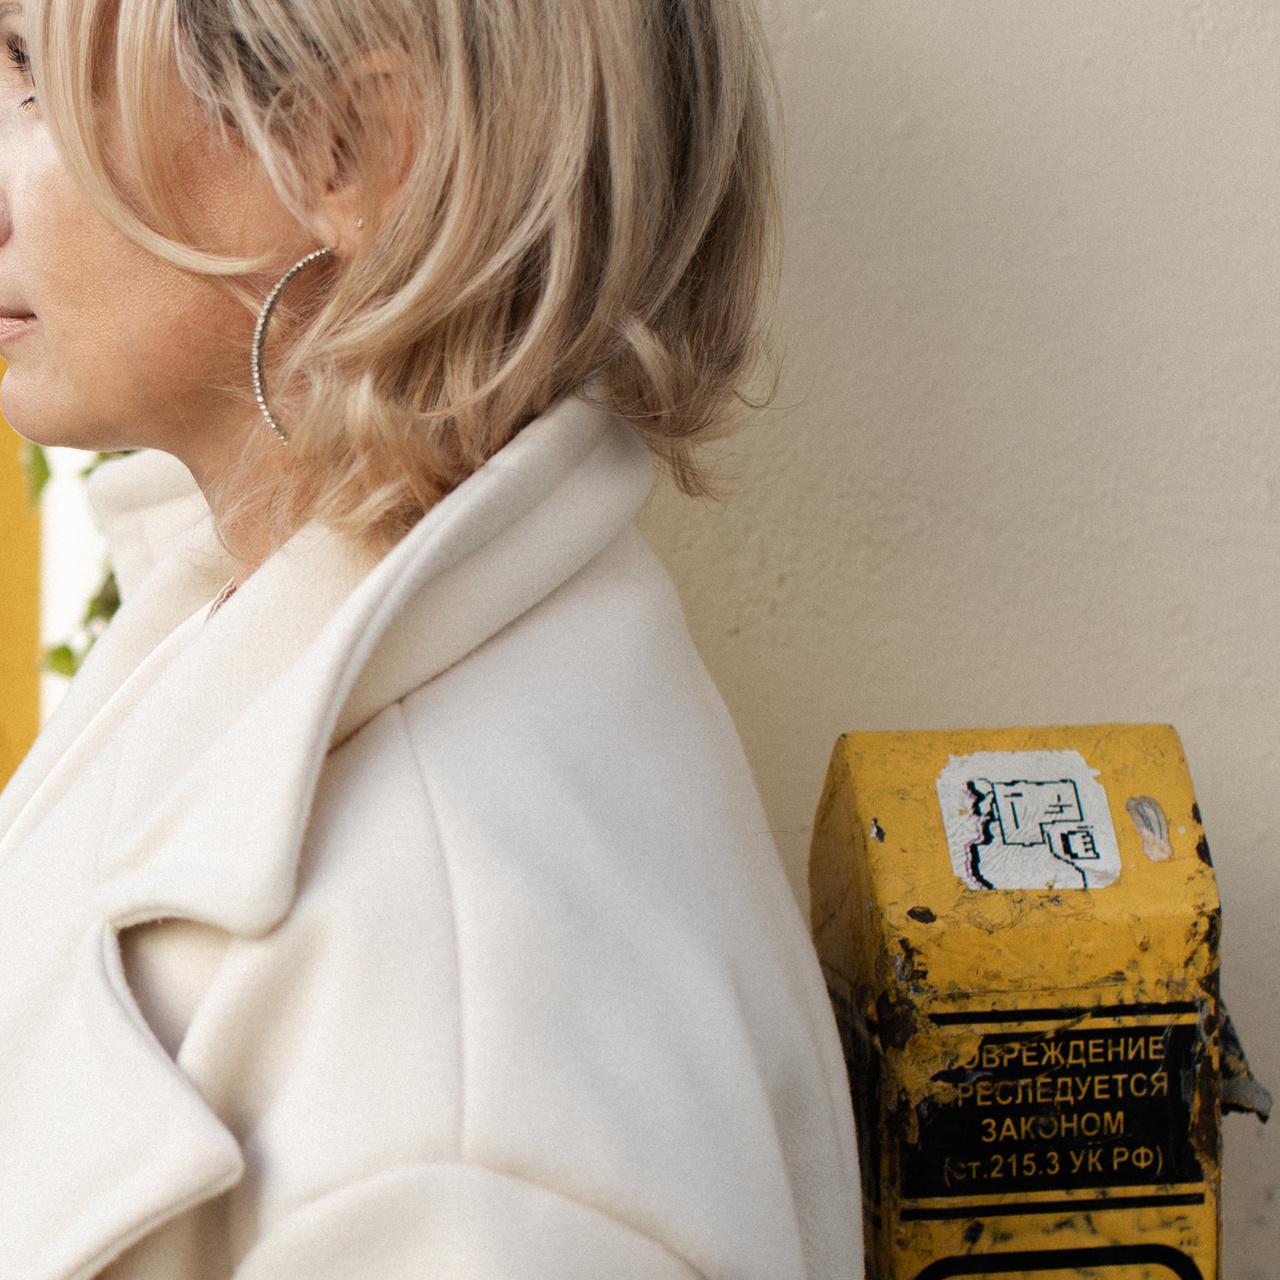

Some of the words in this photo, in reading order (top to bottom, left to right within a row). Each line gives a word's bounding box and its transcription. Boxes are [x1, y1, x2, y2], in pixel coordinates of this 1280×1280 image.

[962, 1035, 1166, 1070] ВРЕЖДЕНИЕ
[937, 1072, 1169, 1107] РЕСЛЕДУЕТСЯ
[980, 1111, 1125, 1143] ЗАКОНОМ
[1069, 1148, 1104, 1175] УК
[1112, 1145, 1163, 1177] РФ)
